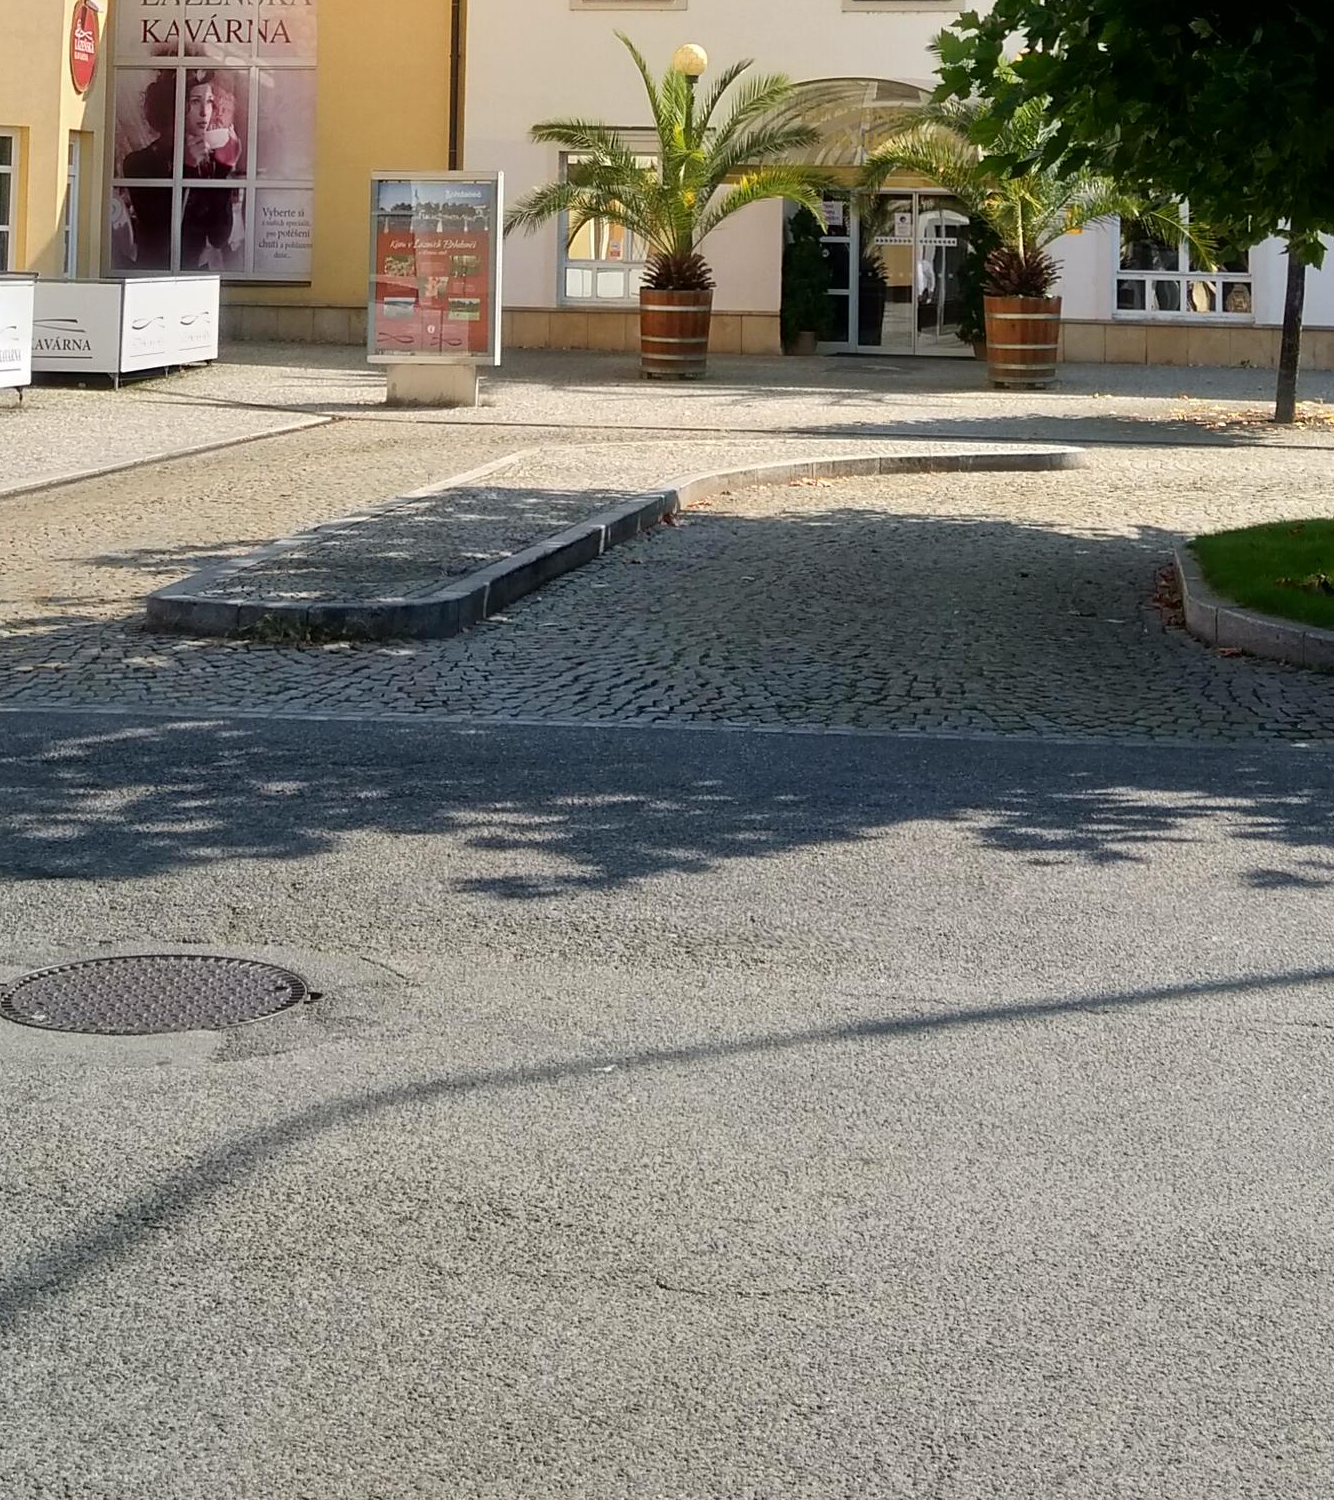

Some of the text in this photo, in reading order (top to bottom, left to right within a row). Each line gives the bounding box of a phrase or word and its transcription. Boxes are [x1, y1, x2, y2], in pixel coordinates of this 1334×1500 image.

[141, 14, 291, 44] KAVÁRNA
[262, 207, 296, 220] Vyberte
[33, 337, 91, 351] AVÁRNA
